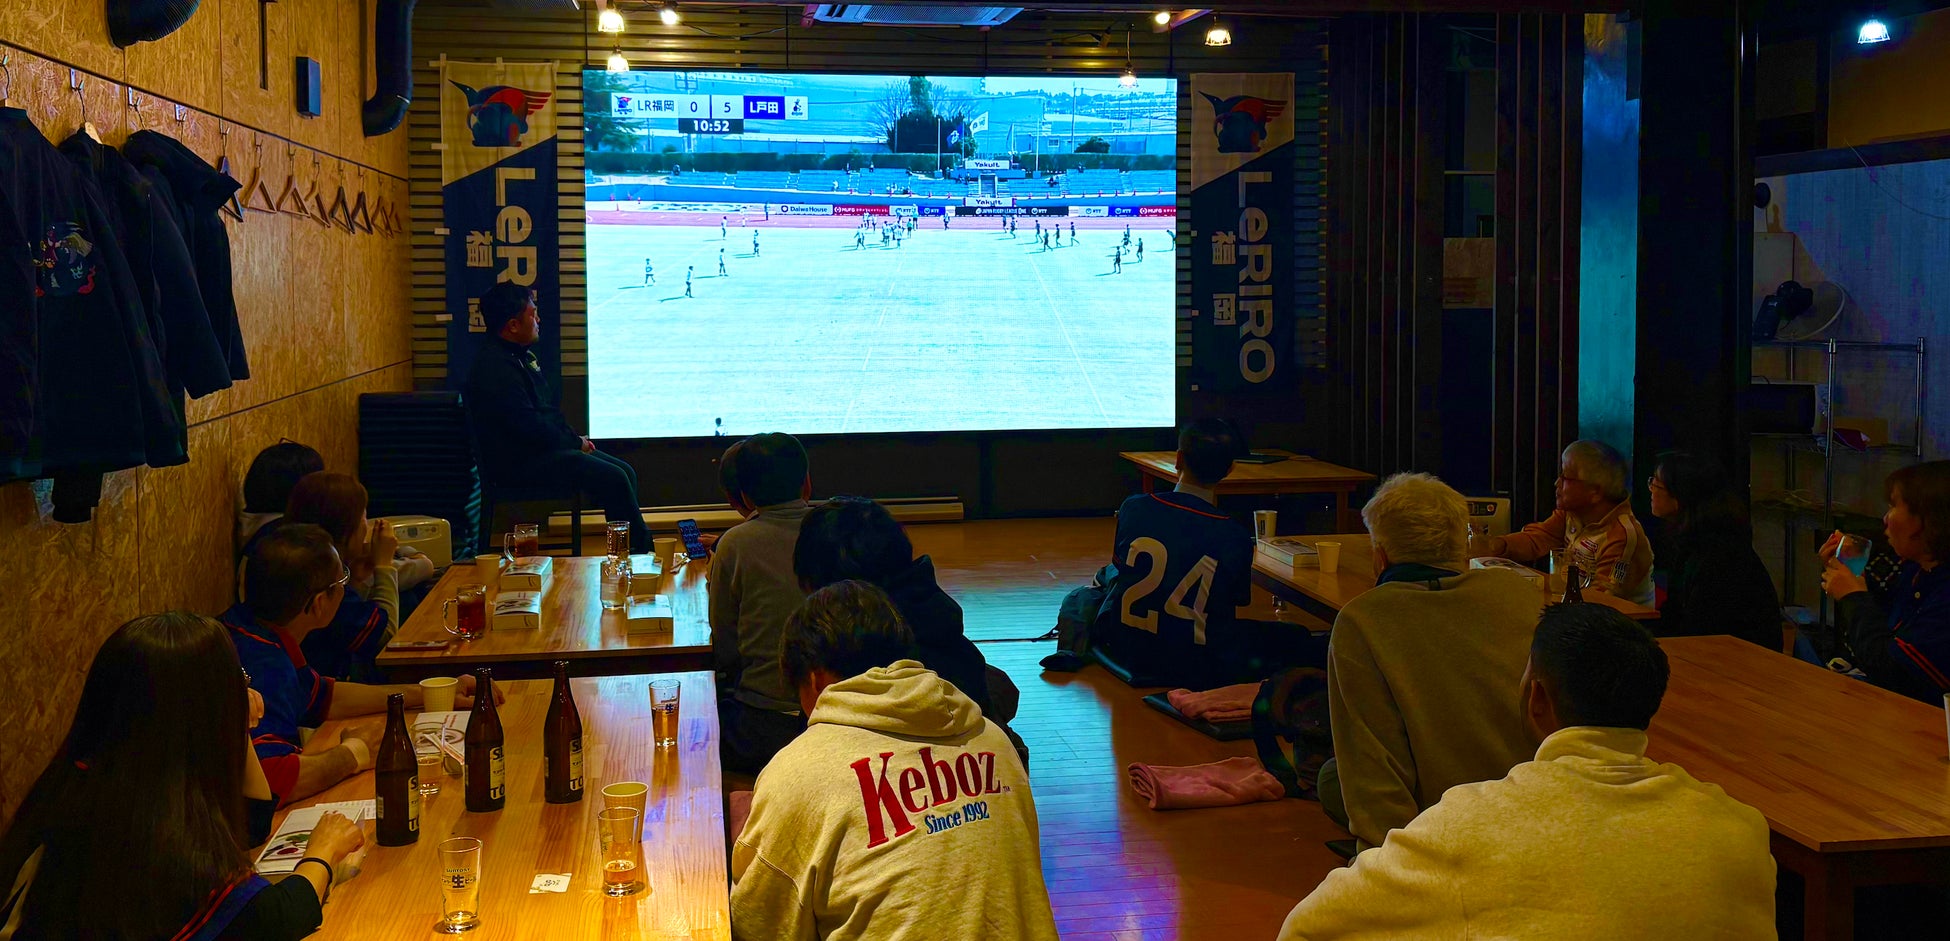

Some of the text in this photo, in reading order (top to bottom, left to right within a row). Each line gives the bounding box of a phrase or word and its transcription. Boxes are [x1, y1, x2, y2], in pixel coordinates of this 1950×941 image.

[637, 100, 675, 112] LR福岡
[690, 101, 698, 113] 0
[723, 102, 731, 113] 5
[749, 101, 779, 114] L戸田
[693, 120, 730, 132] 10:52
[496, 167, 538, 301] LeR
[1211, 230, 1236, 326] 福岡
[1238, 171, 1276, 384] LeRIRO
[1120, 536, 1219, 646] 24
[850, 746, 1001, 849] Keboz
[924, 801, 990, 835] Since 1992
